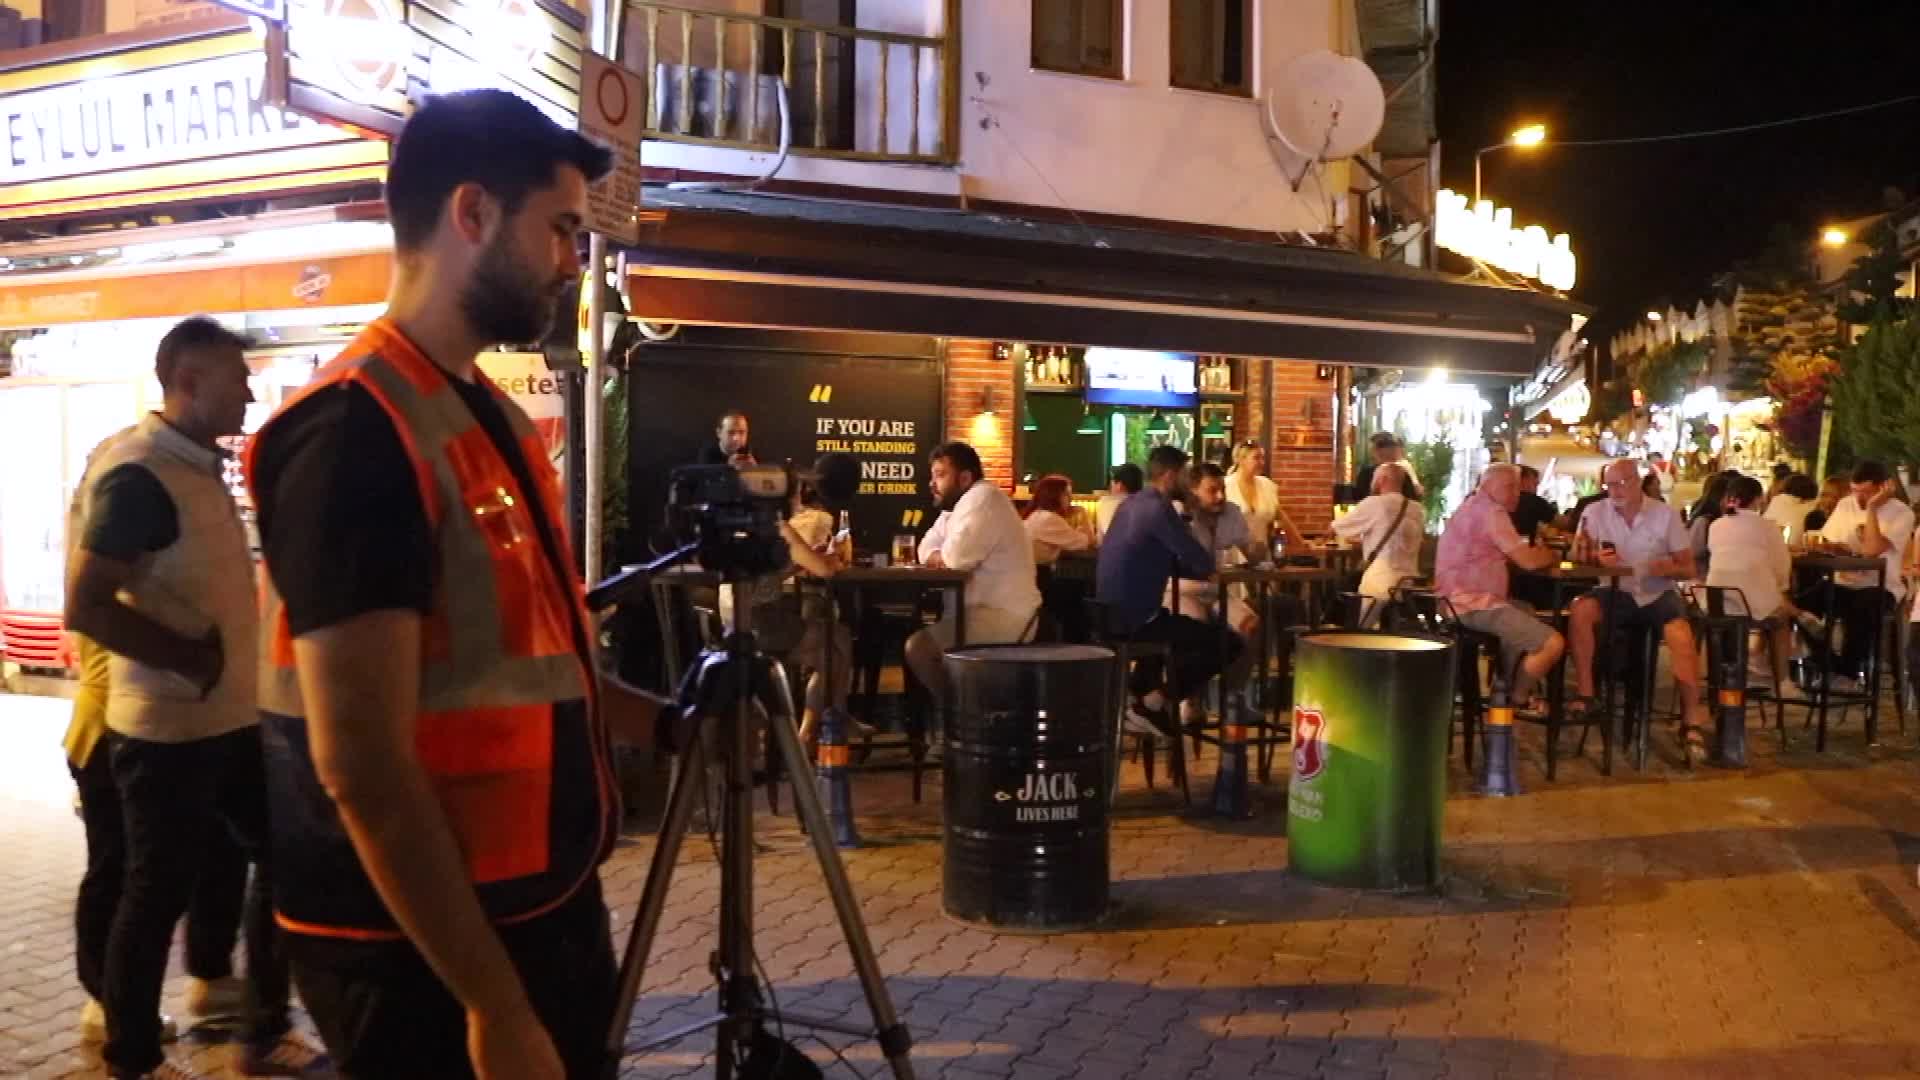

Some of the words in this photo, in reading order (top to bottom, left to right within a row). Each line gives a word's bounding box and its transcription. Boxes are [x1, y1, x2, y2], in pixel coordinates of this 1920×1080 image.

[816, 418, 834, 435] IF
[838, 419, 875, 436] YOU
[878, 421, 915, 437] ARE
[816, 440, 851, 453] STILL
[853, 441, 916, 454] STANDING
[861, 461, 915, 480] NEED
[878, 482, 917, 495] DRINK
[1016, 773, 1078, 801] JACK
[1016, 807, 1050, 822] LIVES
[1051, 805, 1080, 821] HERE
